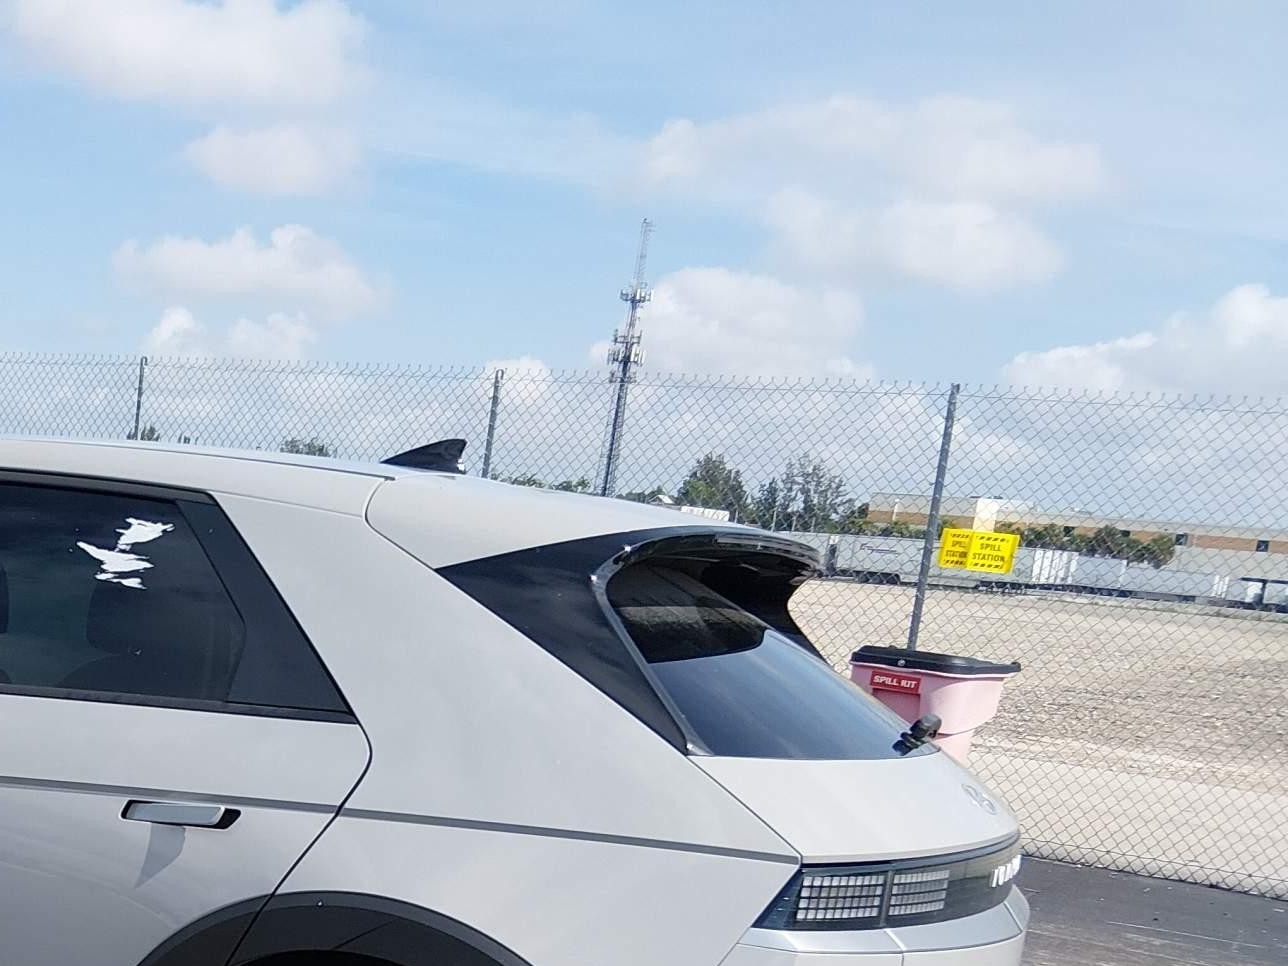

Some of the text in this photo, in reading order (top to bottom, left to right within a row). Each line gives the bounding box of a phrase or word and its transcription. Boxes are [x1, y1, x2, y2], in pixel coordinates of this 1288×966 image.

[979, 542, 1001, 552] SPILL
[972, 552, 1006, 562] STATION
[873, 675, 918, 689] SPILL KIT
